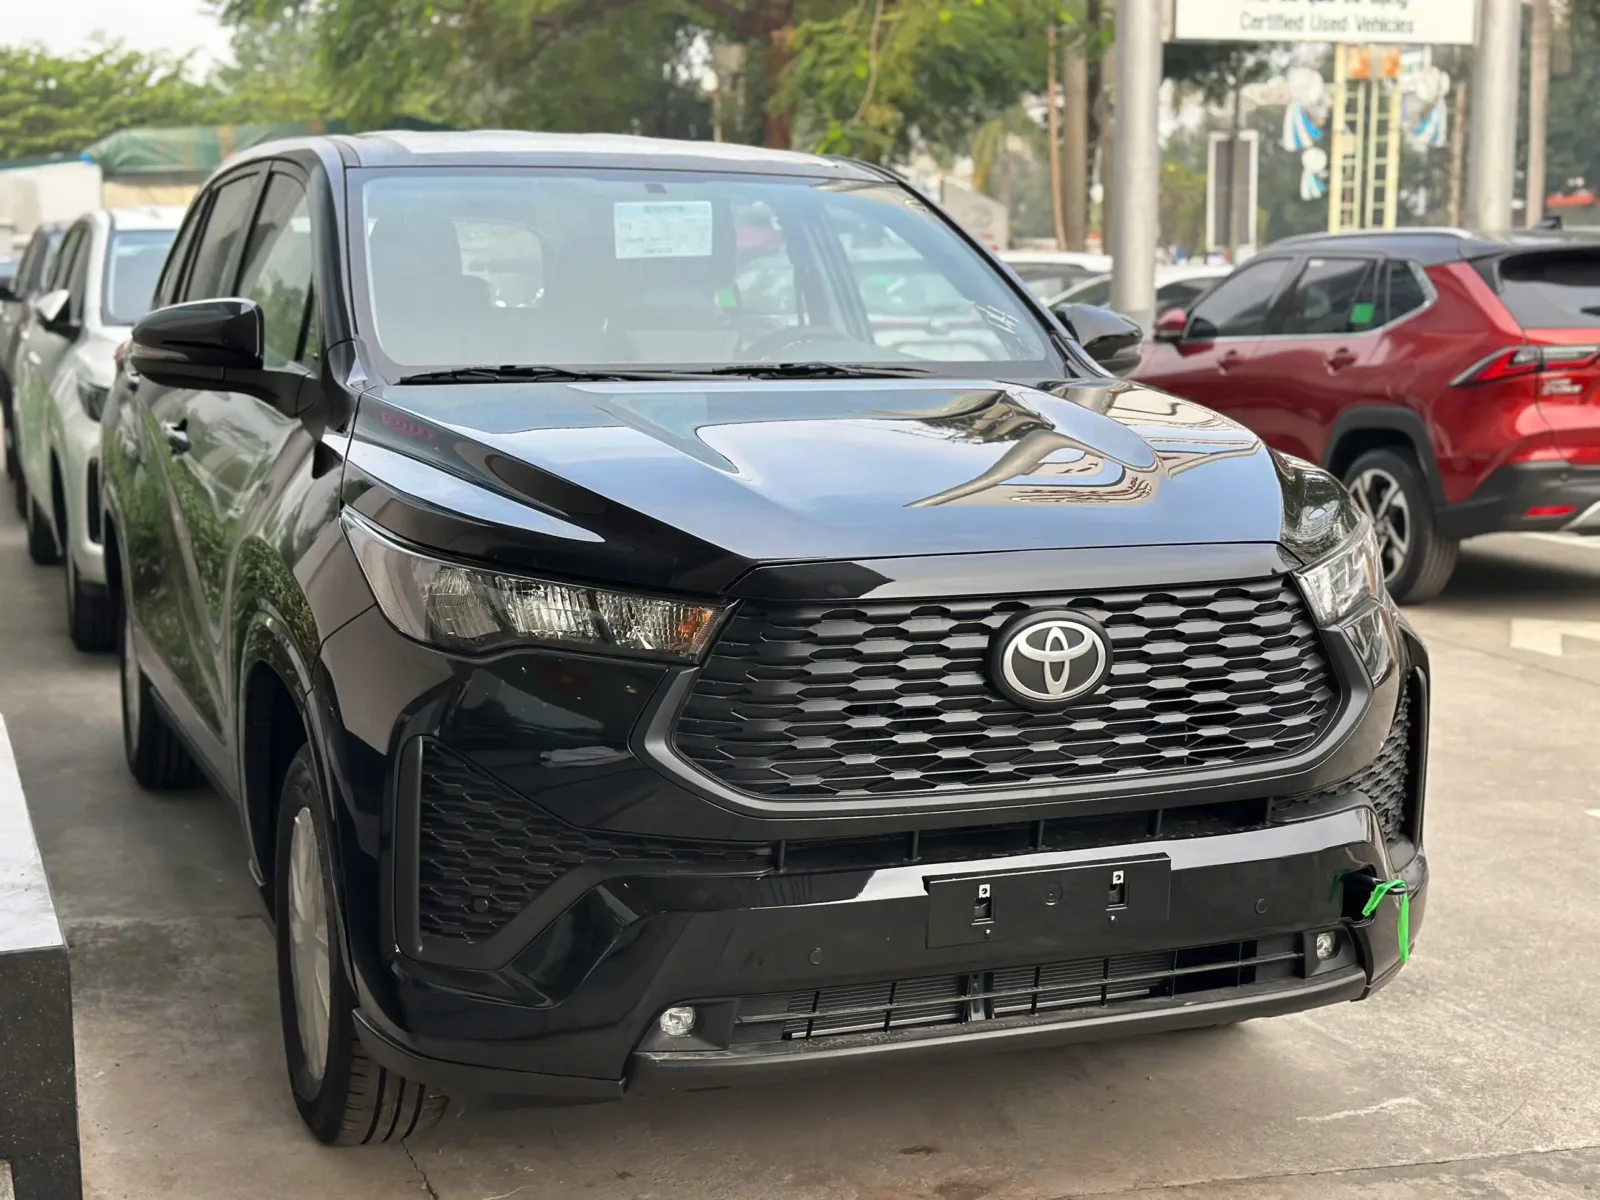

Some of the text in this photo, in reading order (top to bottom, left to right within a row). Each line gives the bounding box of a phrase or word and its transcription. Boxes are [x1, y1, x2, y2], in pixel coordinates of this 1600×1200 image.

[1240, 13, 1414, 32] Certified Used Vehicles
